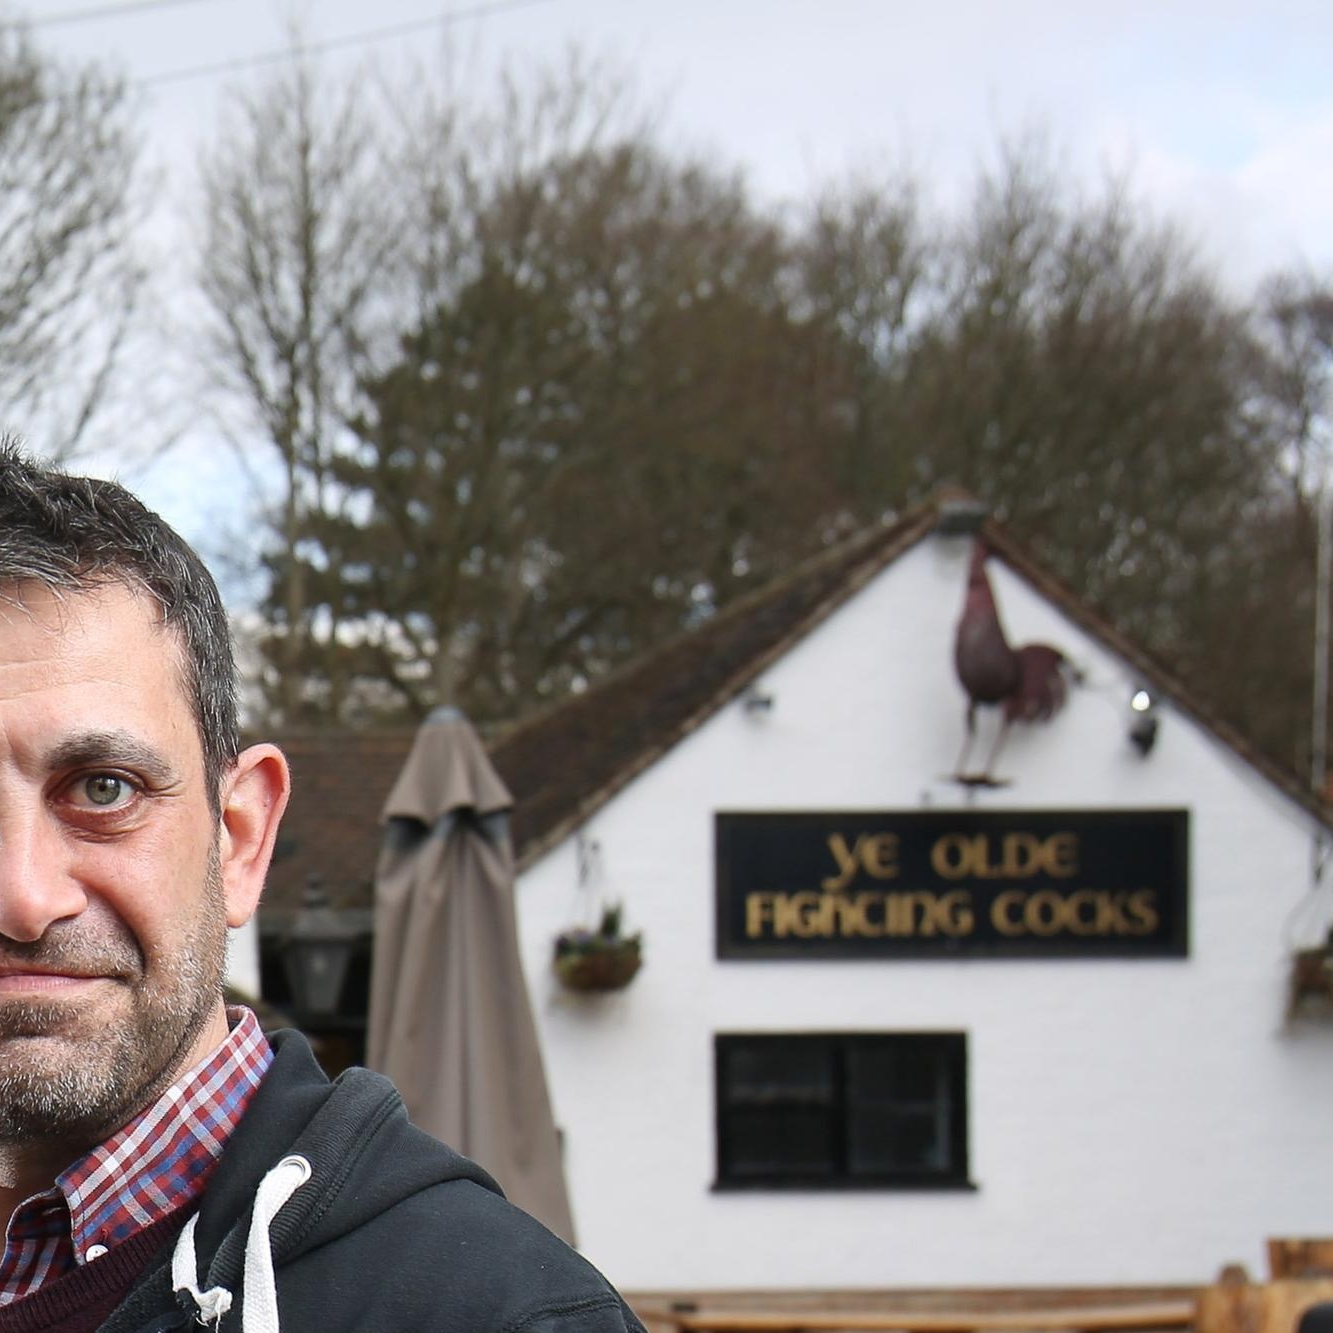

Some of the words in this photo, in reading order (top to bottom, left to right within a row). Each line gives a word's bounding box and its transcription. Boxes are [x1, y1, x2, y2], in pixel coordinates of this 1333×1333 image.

[931, 832, 1080, 880] OLDE
[745, 890, 975, 939] FIGHTING
[990, 890, 1160, 936] COCKS
